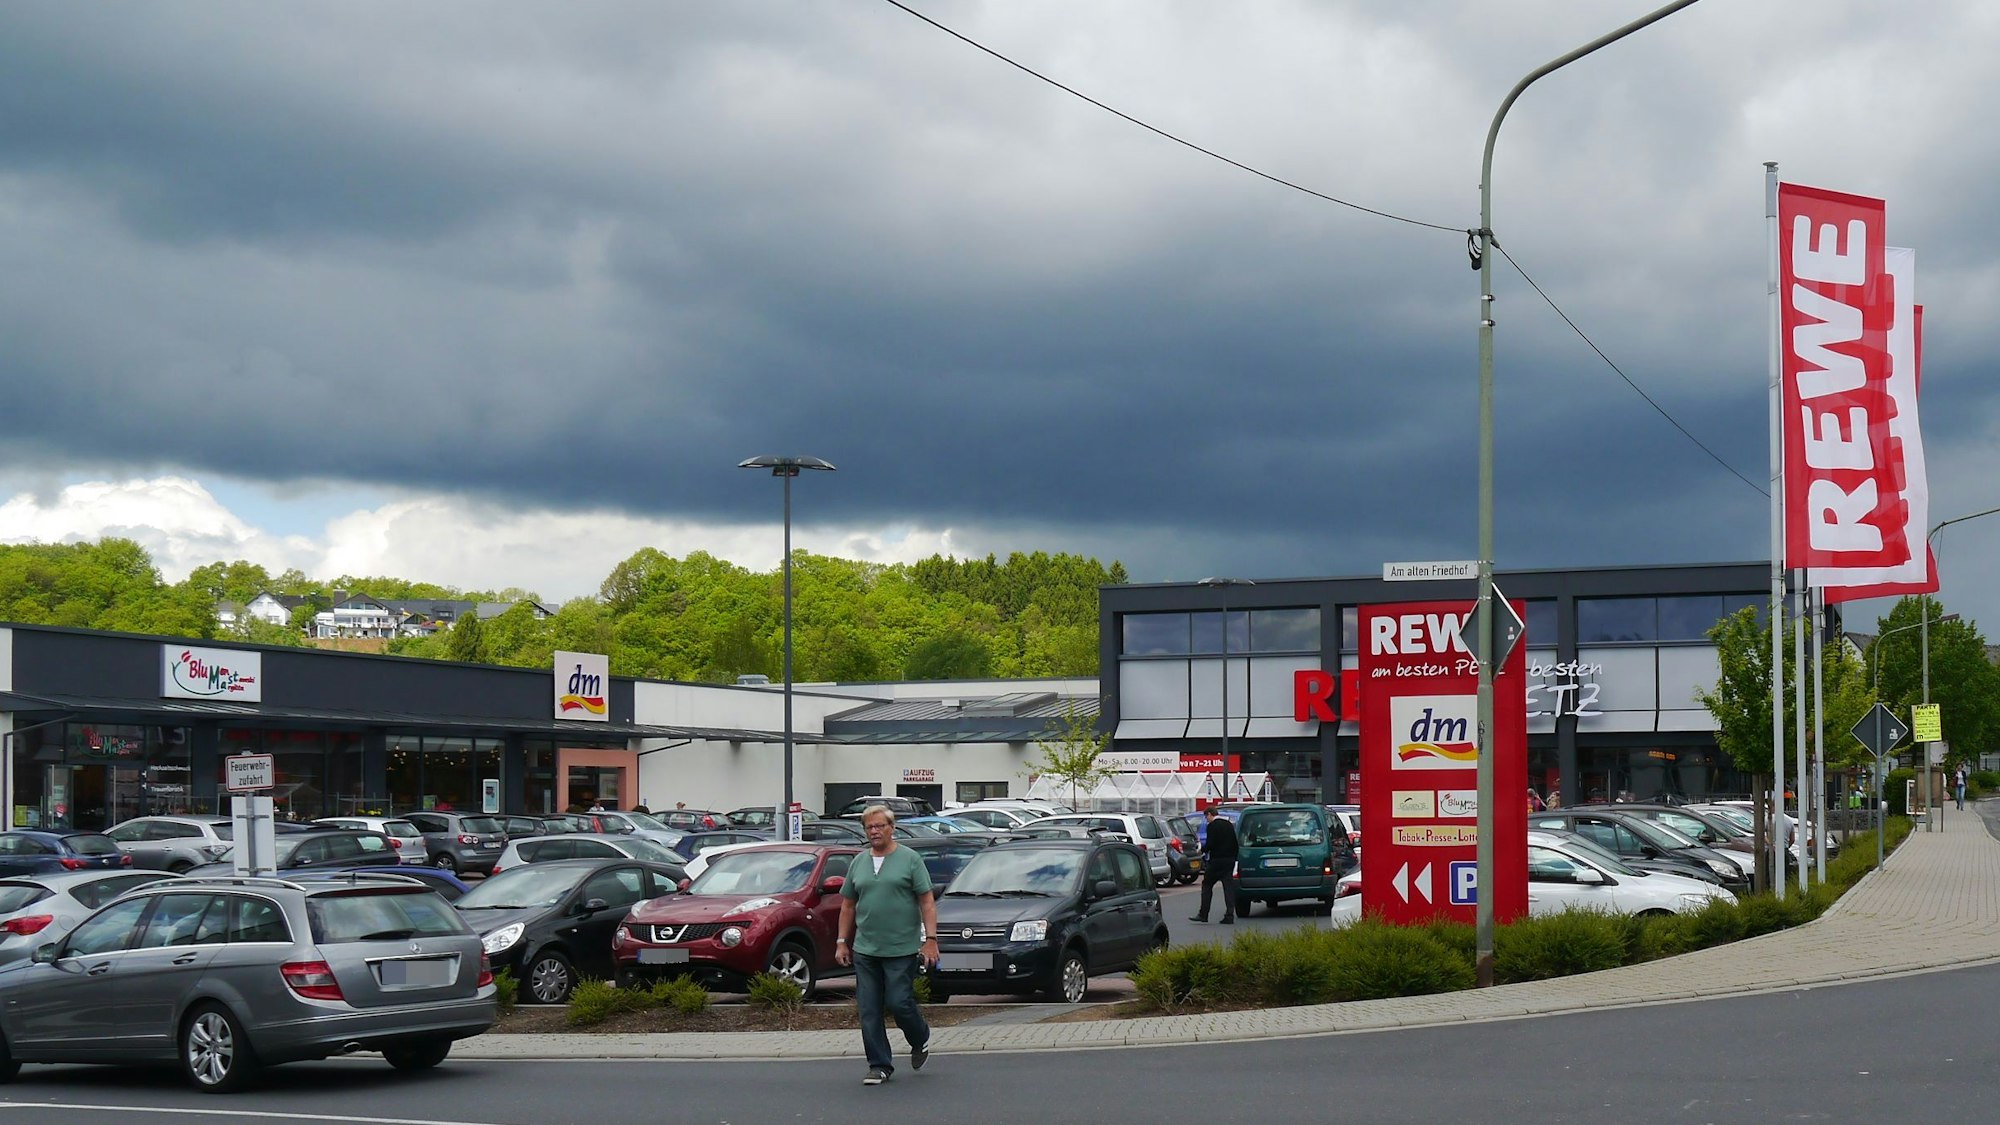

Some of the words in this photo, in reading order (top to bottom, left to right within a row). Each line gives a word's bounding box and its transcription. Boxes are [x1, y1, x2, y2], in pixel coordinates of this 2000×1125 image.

[1793, 215, 1883, 552] REWE
[1390, 565, 1405, 577] Am
[1407, 565, 1429, 577] alten
[1432, 563, 1469, 576] Friedhof
[1371, 613, 1469, 655] REW
[1371, 667, 1392, 678] am
[1395, 661, 1449, 678] besten
[1529, 658, 1603, 677] besten
[568, 664, 601, 696] dm
[1293, 669, 1360, 723] RE
[1525, 682, 1604, 718] ETZ
[1410, 708, 1468, 743] dm
[230, 760, 270, 772] Feuerwehr-
[1161, 757, 1173, 765] Uhr
[238, 774, 264, 786] zufahrt
[1397, 829, 1421, 842] Tabak
[1425, 829, 1452, 842] Presse
